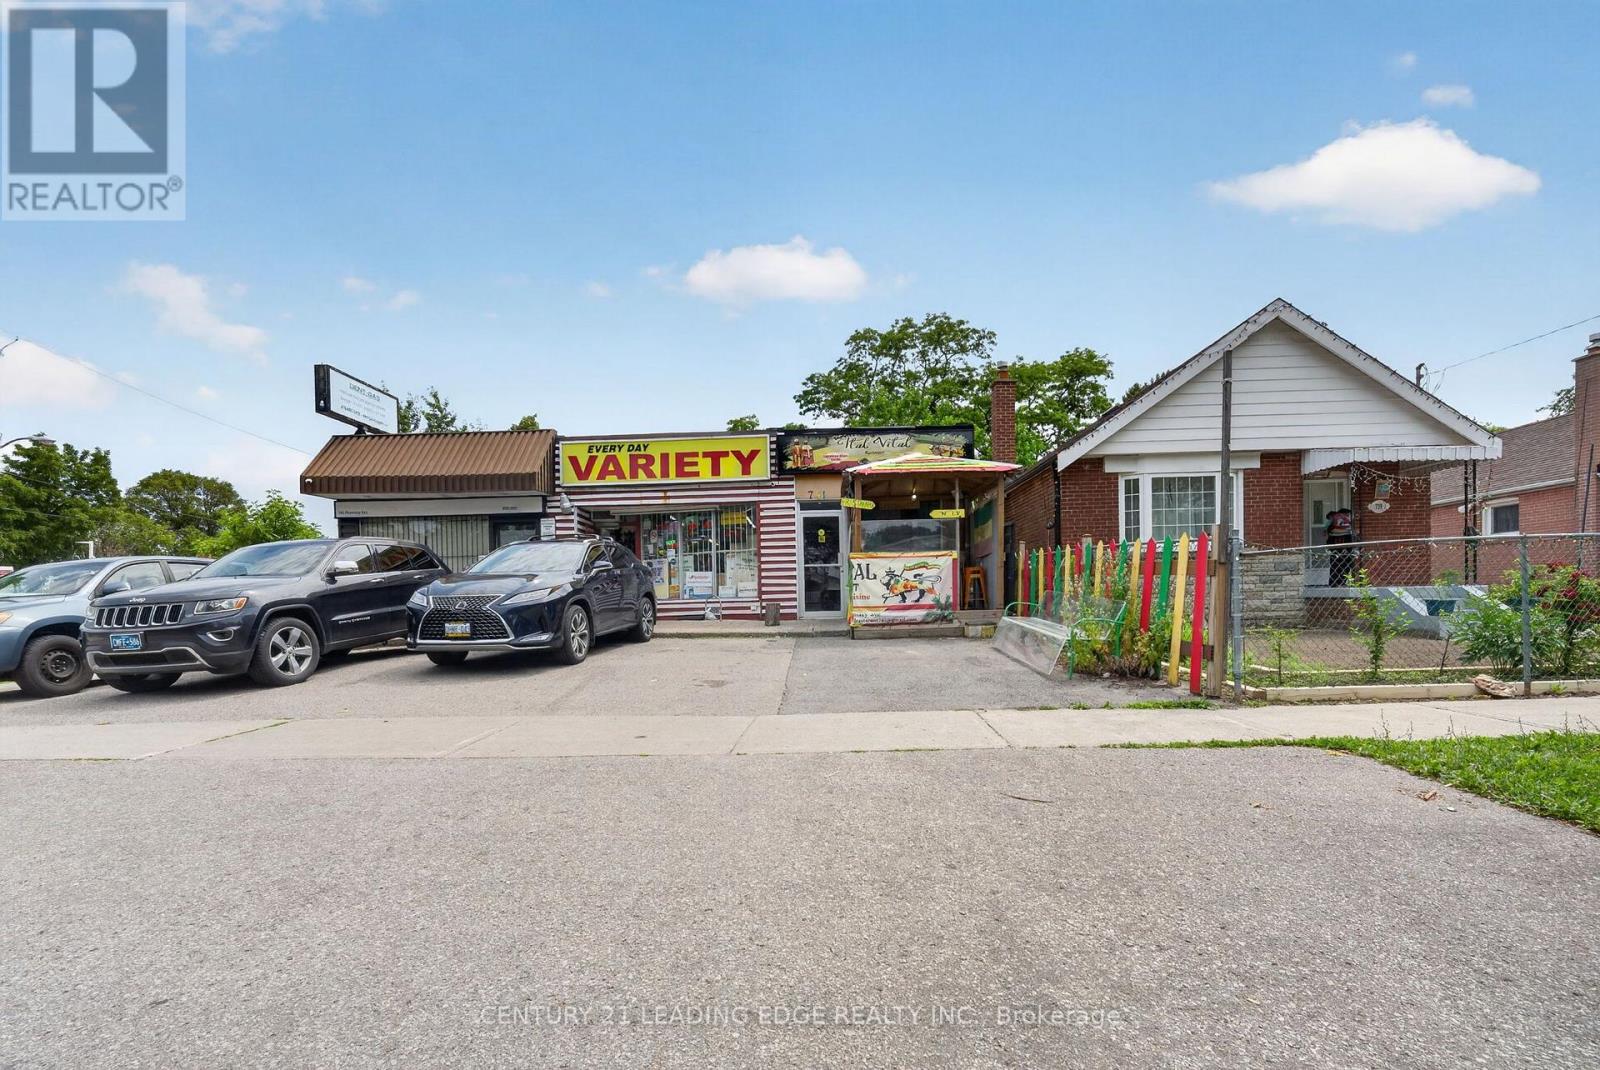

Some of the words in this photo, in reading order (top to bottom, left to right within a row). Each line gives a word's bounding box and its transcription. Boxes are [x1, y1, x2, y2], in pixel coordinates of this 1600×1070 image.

[587, 444, 625, 454] EVERY
[627, 443, 650, 453] DAY
[568, 449, 762, 481] VARIETY
